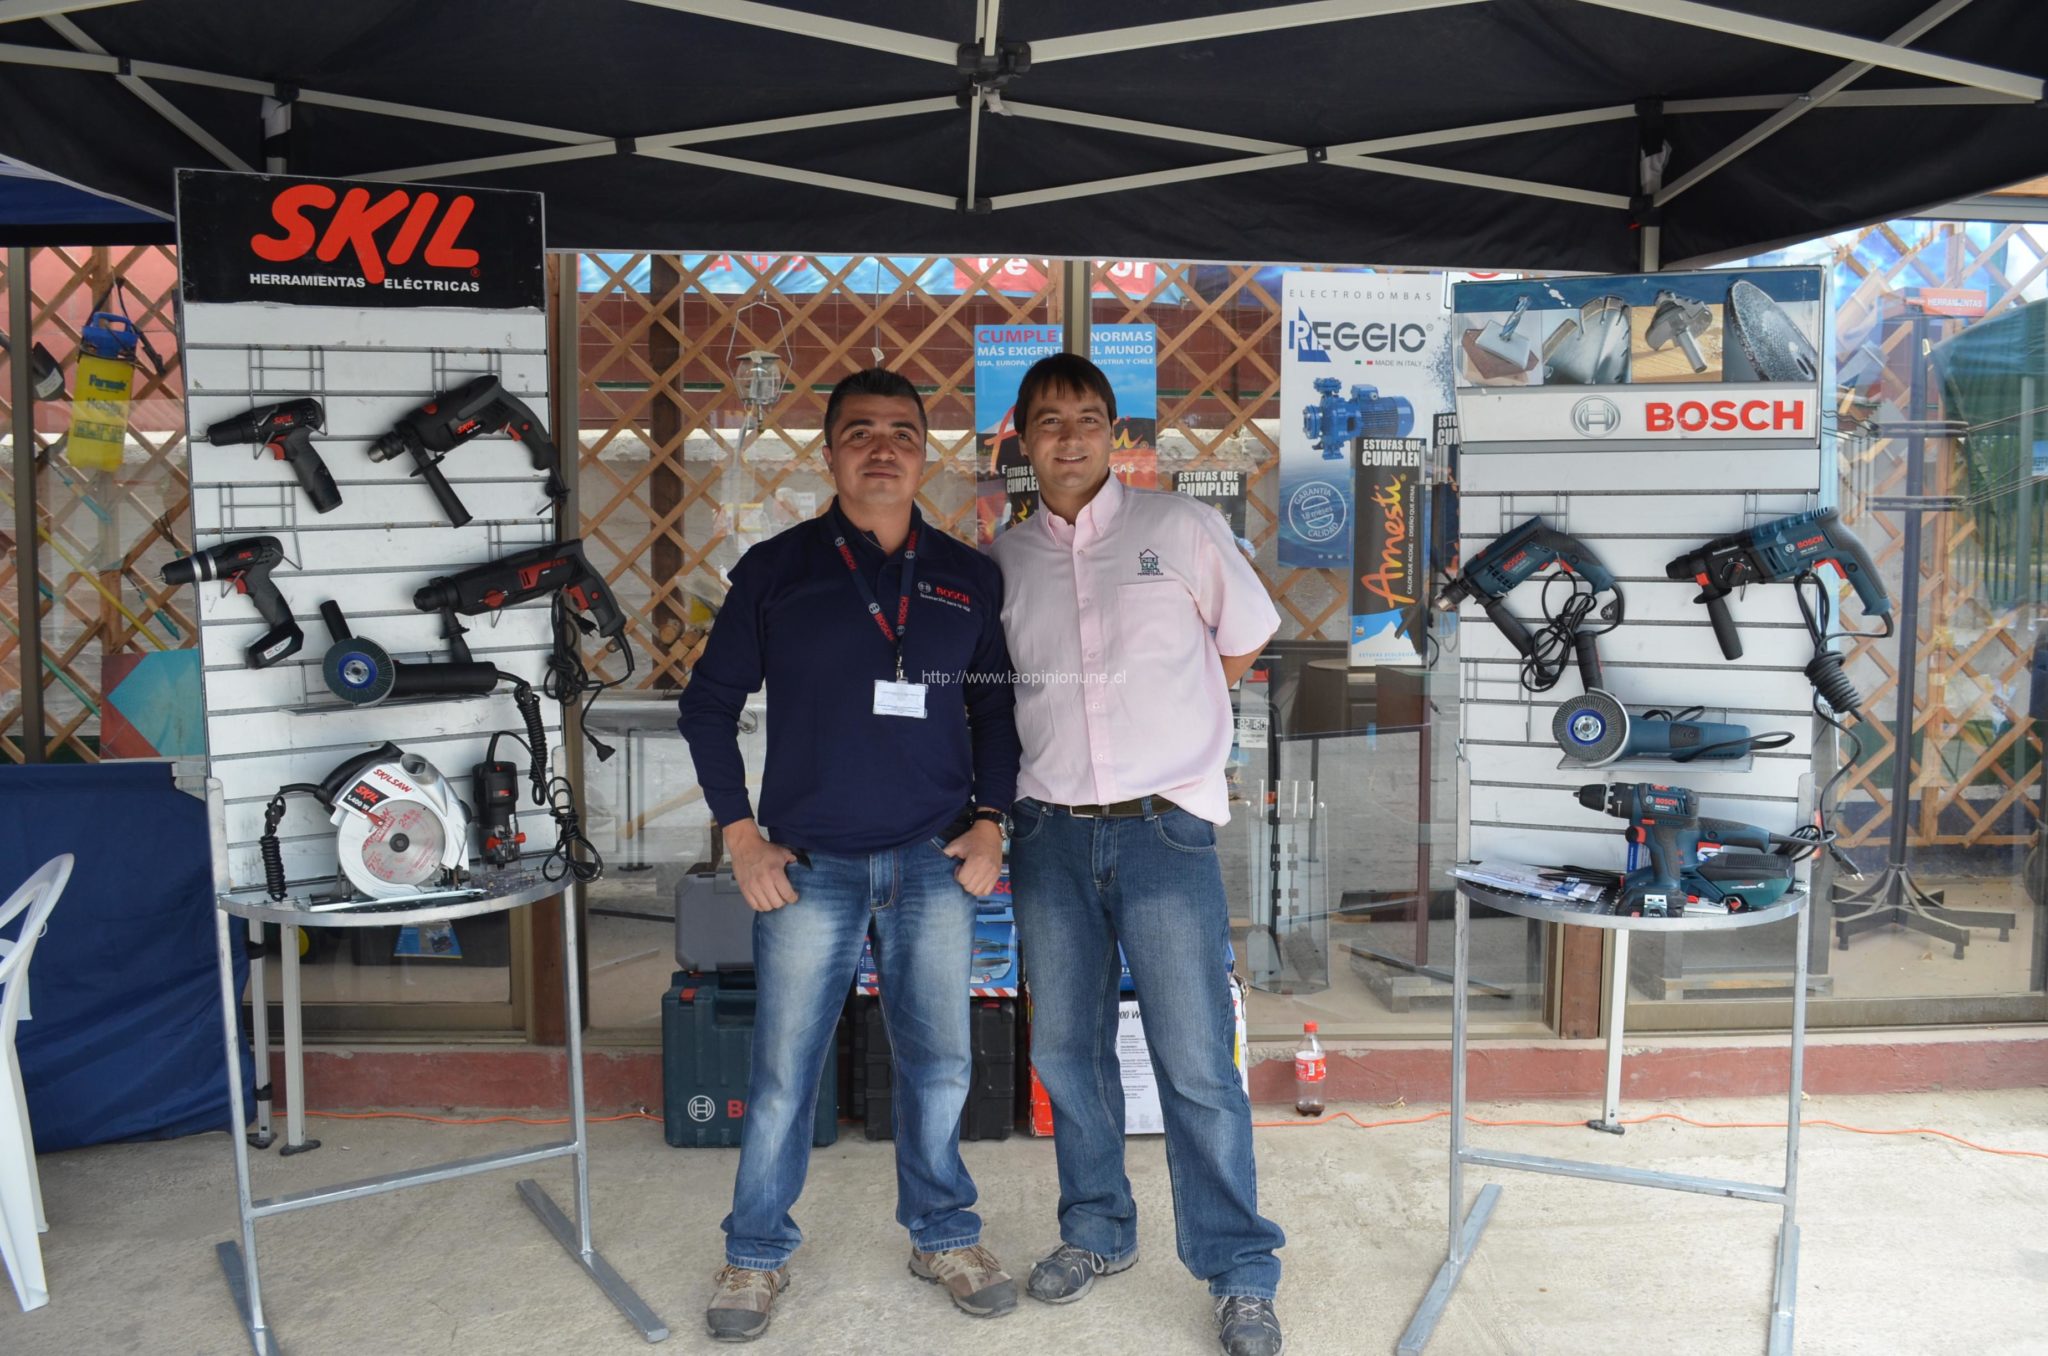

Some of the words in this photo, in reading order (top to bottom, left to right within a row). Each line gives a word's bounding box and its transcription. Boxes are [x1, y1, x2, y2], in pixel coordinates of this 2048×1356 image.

[251, 184, 479, 284] SKIL
[250, 273, 366, 288] HERRAMIENTAS
[384, 278, 480, 292] ELÉCTRICAS
[1289, 289, 1431, 301] ELECTROBOMBAS
[978, 330, 1057, 344] CUMPLE
[1090, 331, 1153, 343] NORMAS
[1289, 319, 1426, 353] REGGIO
[977, 345, 1005, 356] MÁS
[1009, 346, 1063, 356] EXIGENT
[1105, 345, 1153, 354] MUNDO
[1646, 400, 1804, 432] BOSCH
[1363, 439, 1403, 450] ESTUFAS
[1362, 451, 1420, 466] CUMPLEN
[1178, 472, 1218, 482] ESTUFAS
[1220, 471, 1239, 481] QUE
[1177, 481, 1239, 497] CUMPLEN
[1308, 521, 1339, 537] CALIDAD
[1361, 474, 1416, 608] Amesti
[1797, 535, 1824, 549] BOSCH
[1503, 550, 1527, 572] BOSCH
[936, 586, 970, 604] BOSCH
[898, 596, 909, 625] BOSCH
[874, 612, 895, 641] BOSCH
[373, 769, 412, 793] SKILSAW
[355, 786, 379, 804] SKIL
[1655, 797, 1677, 806] BOSCH
